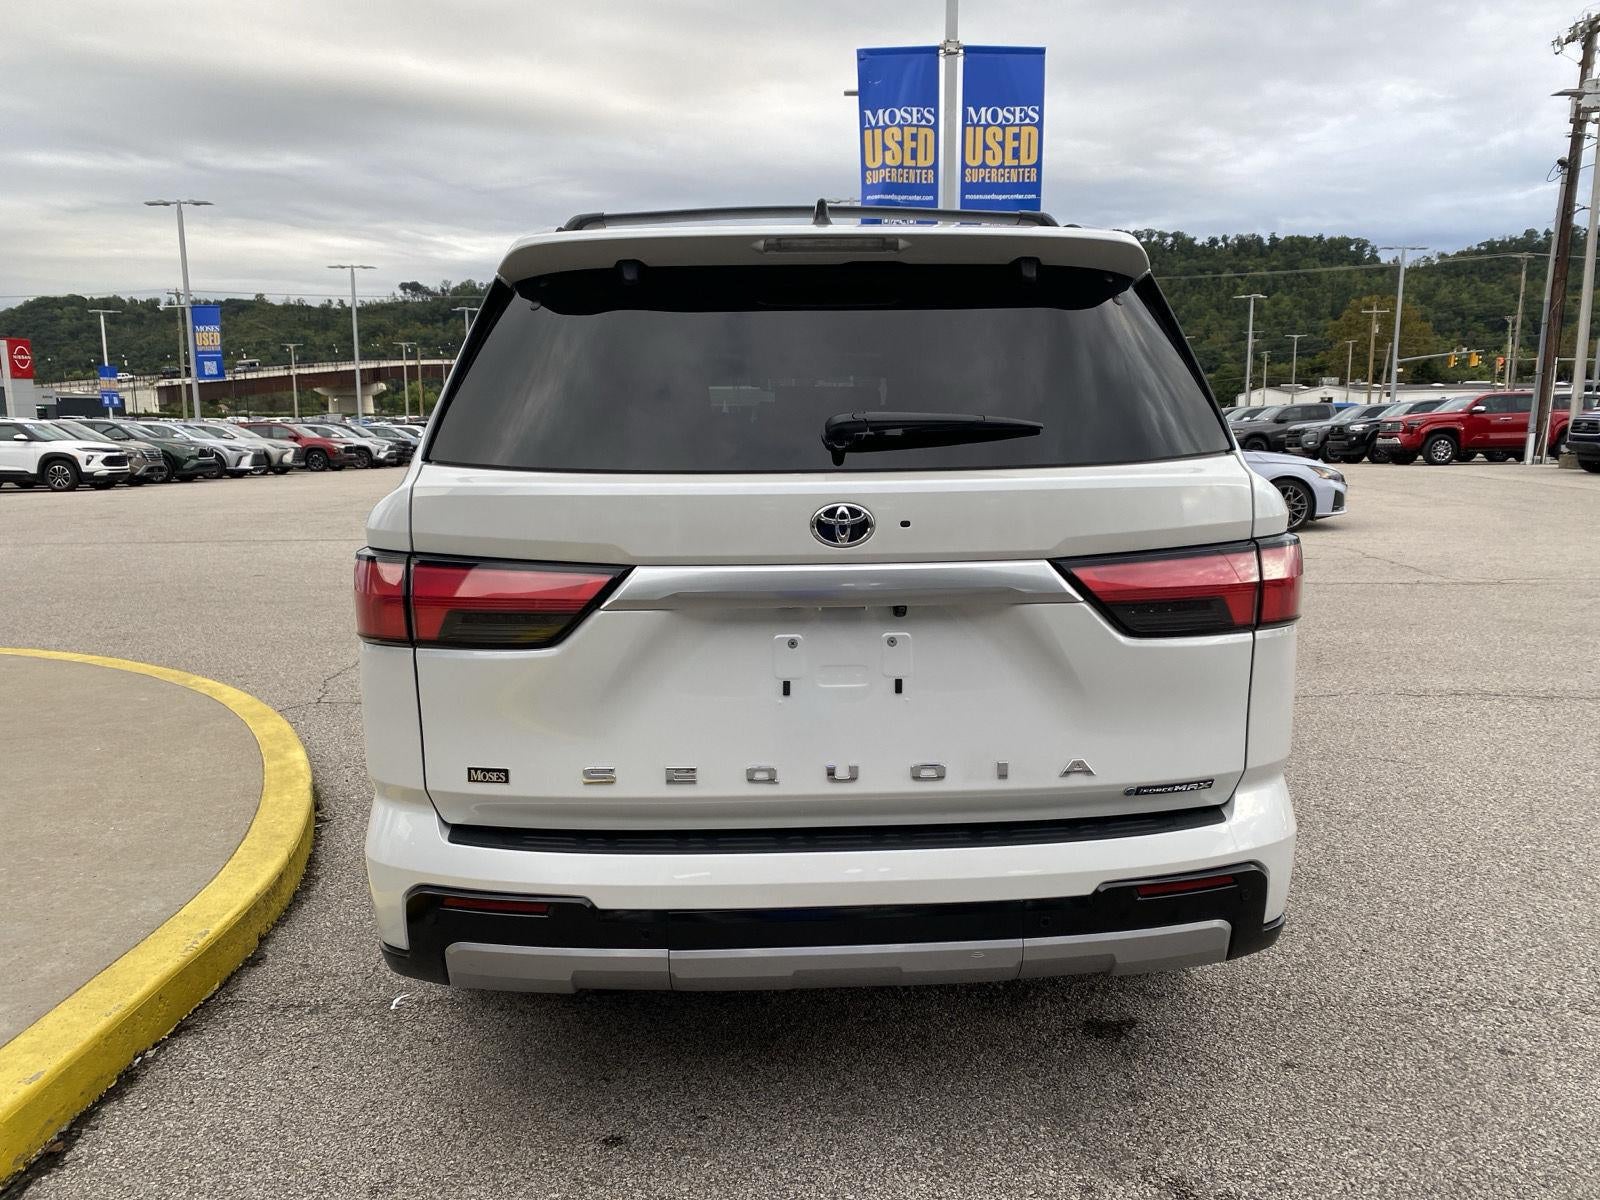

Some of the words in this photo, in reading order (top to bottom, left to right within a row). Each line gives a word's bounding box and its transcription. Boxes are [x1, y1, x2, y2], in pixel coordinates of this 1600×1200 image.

[864, 107, 935, 127] MOSES
[966, 106, 1039, 125] MOSES
[864, 127, 935, 168] USED
[965, 126, 1039, 166] USED
[866, 168, 934, 184] SUPERCENTER
[965, 168, 1037, 183] SUPERCENTER
[866, 193, 934, 201] mosesusedsupercenter.com
[196, 332, 221, 346] USED
[470, 769, 506, 782] MOSES
[582, 757, 1096, 785] SEQUOIA
